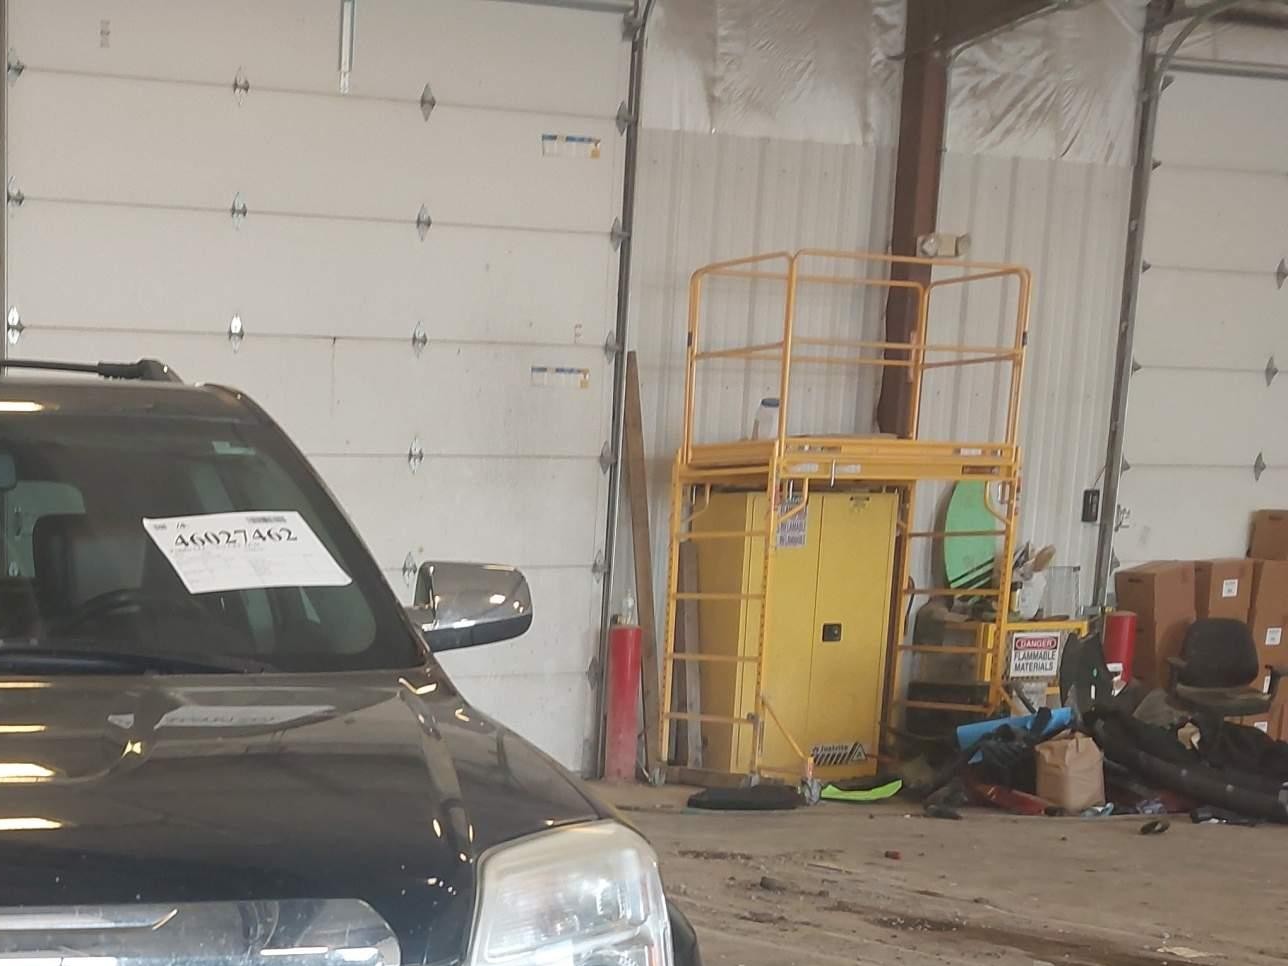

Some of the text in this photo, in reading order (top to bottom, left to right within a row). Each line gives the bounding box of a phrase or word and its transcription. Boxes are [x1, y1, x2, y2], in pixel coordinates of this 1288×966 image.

[174, 527, 297, 547] 46027462
[1020, 639, 1053, 649] DANGER
[1014, 650, 1057, 661] FLAMMABLE
[1014, 661, 1054, 672] MATERIALS
